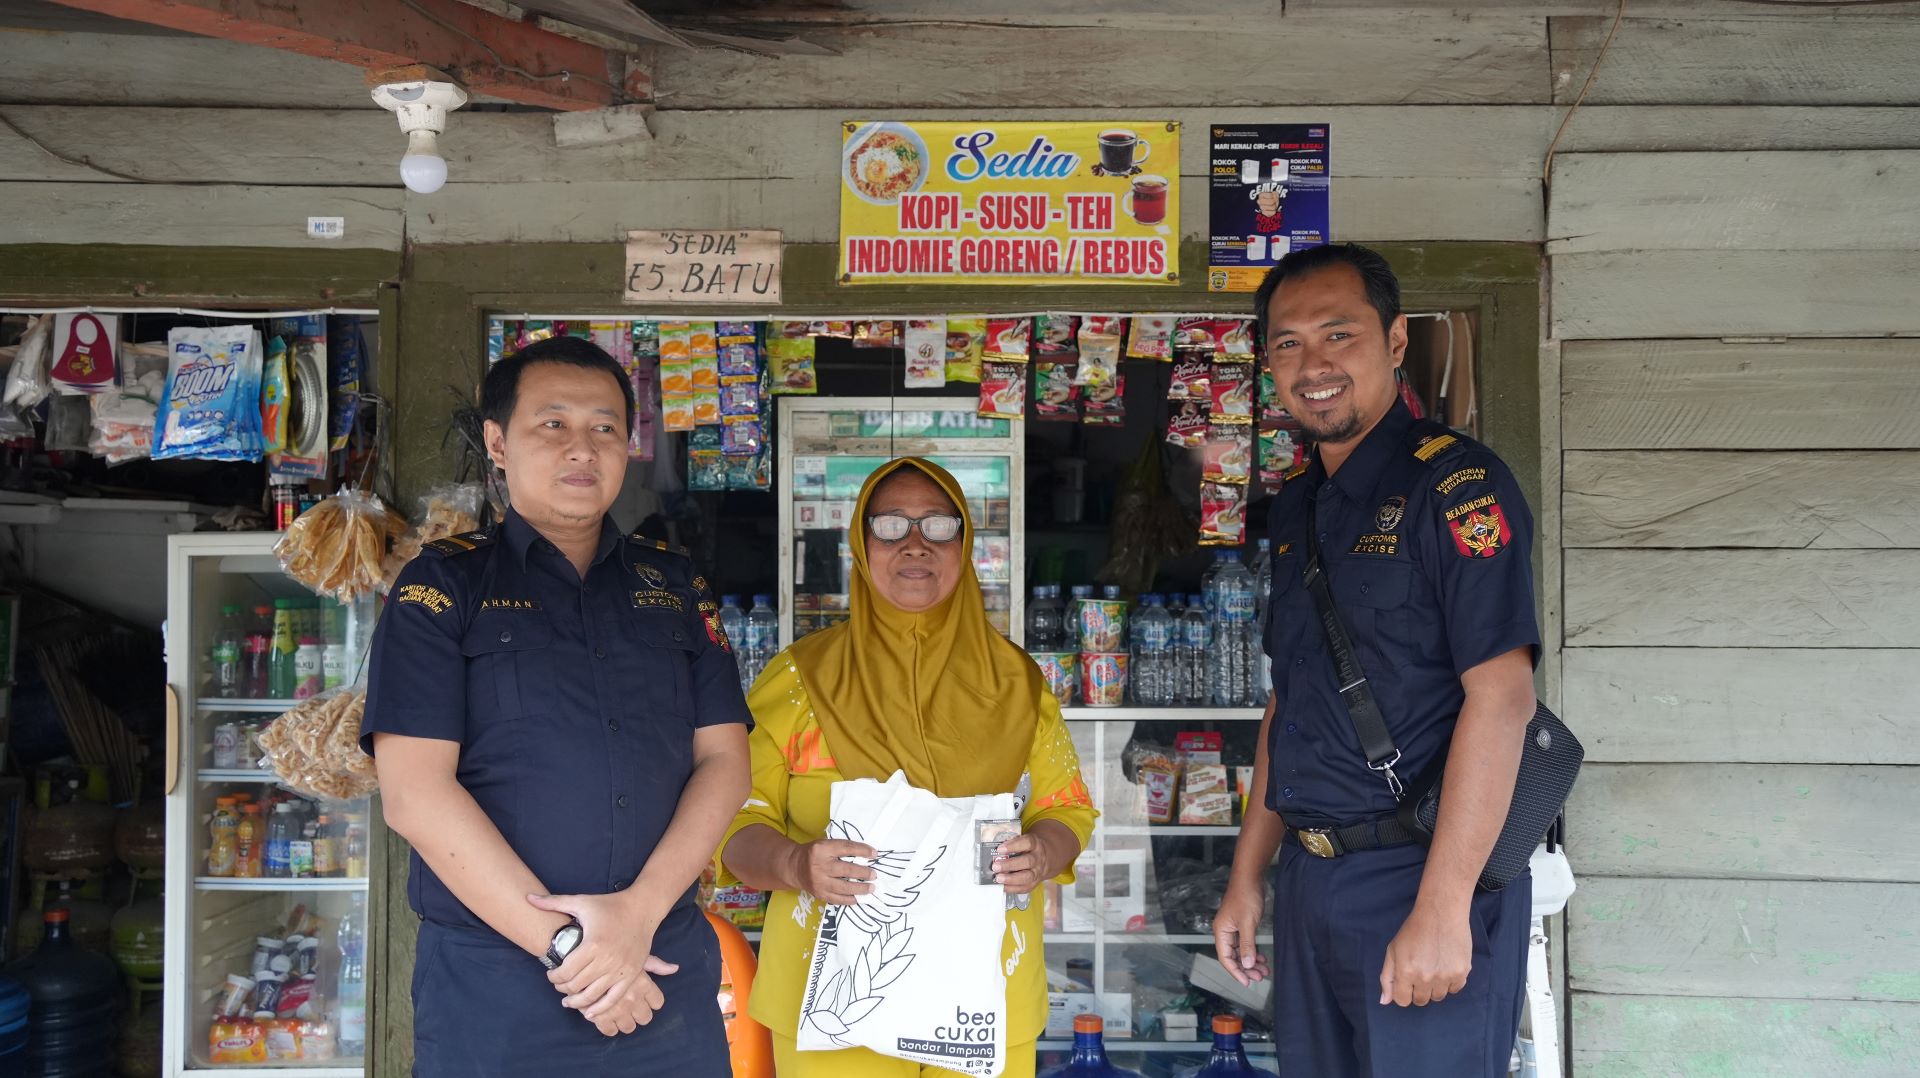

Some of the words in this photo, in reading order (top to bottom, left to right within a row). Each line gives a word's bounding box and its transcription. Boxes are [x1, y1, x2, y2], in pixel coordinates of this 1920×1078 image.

[947, 132, 1080, 181] Sedia
[1213, 166, 1236, 174] POLOS
[1249, 182, 1289, 200] GEMPUR
[901, 195, 959, 230] KOPI
[980, 195, 1047, 231] SUSU
[1067, 195, 1112, 230] TEH
[849, 239, 954, 274] INDOMIE
[960, 239, 1058, 275] GORENG
[1064, 239, 1078, 274] /
[1084, 239, 1165, 275] REBUS
[171, 362, 235, 401] BOOM
[1435, 467, 1486, 492] KEMENTERIAN
[1441, 473, 1485, 495] KEUANGAN
[1445, 508, 1460, 521] BEA
[1459, 502, 1475, 516] DAN
[1475, 494, 1496, 509] CUKAI
[1353, 544, 1396, 554] EXCISE
[1359, 535, 1398, 543] CUSTOMS
[400, 584, 426, 593] KANTOR
[427, 586, 453, 608] WILAYAH
[407, 588, 441, 605] SUMATERA
[481, 599, 532, 609] AHMAN
[637, 598, 684, 613] EXCISE
[956, 1005, 995, 1025] bea
[900, 1039, 941, 1053] bandar
[945, 1044, 993, 1057] lampung
